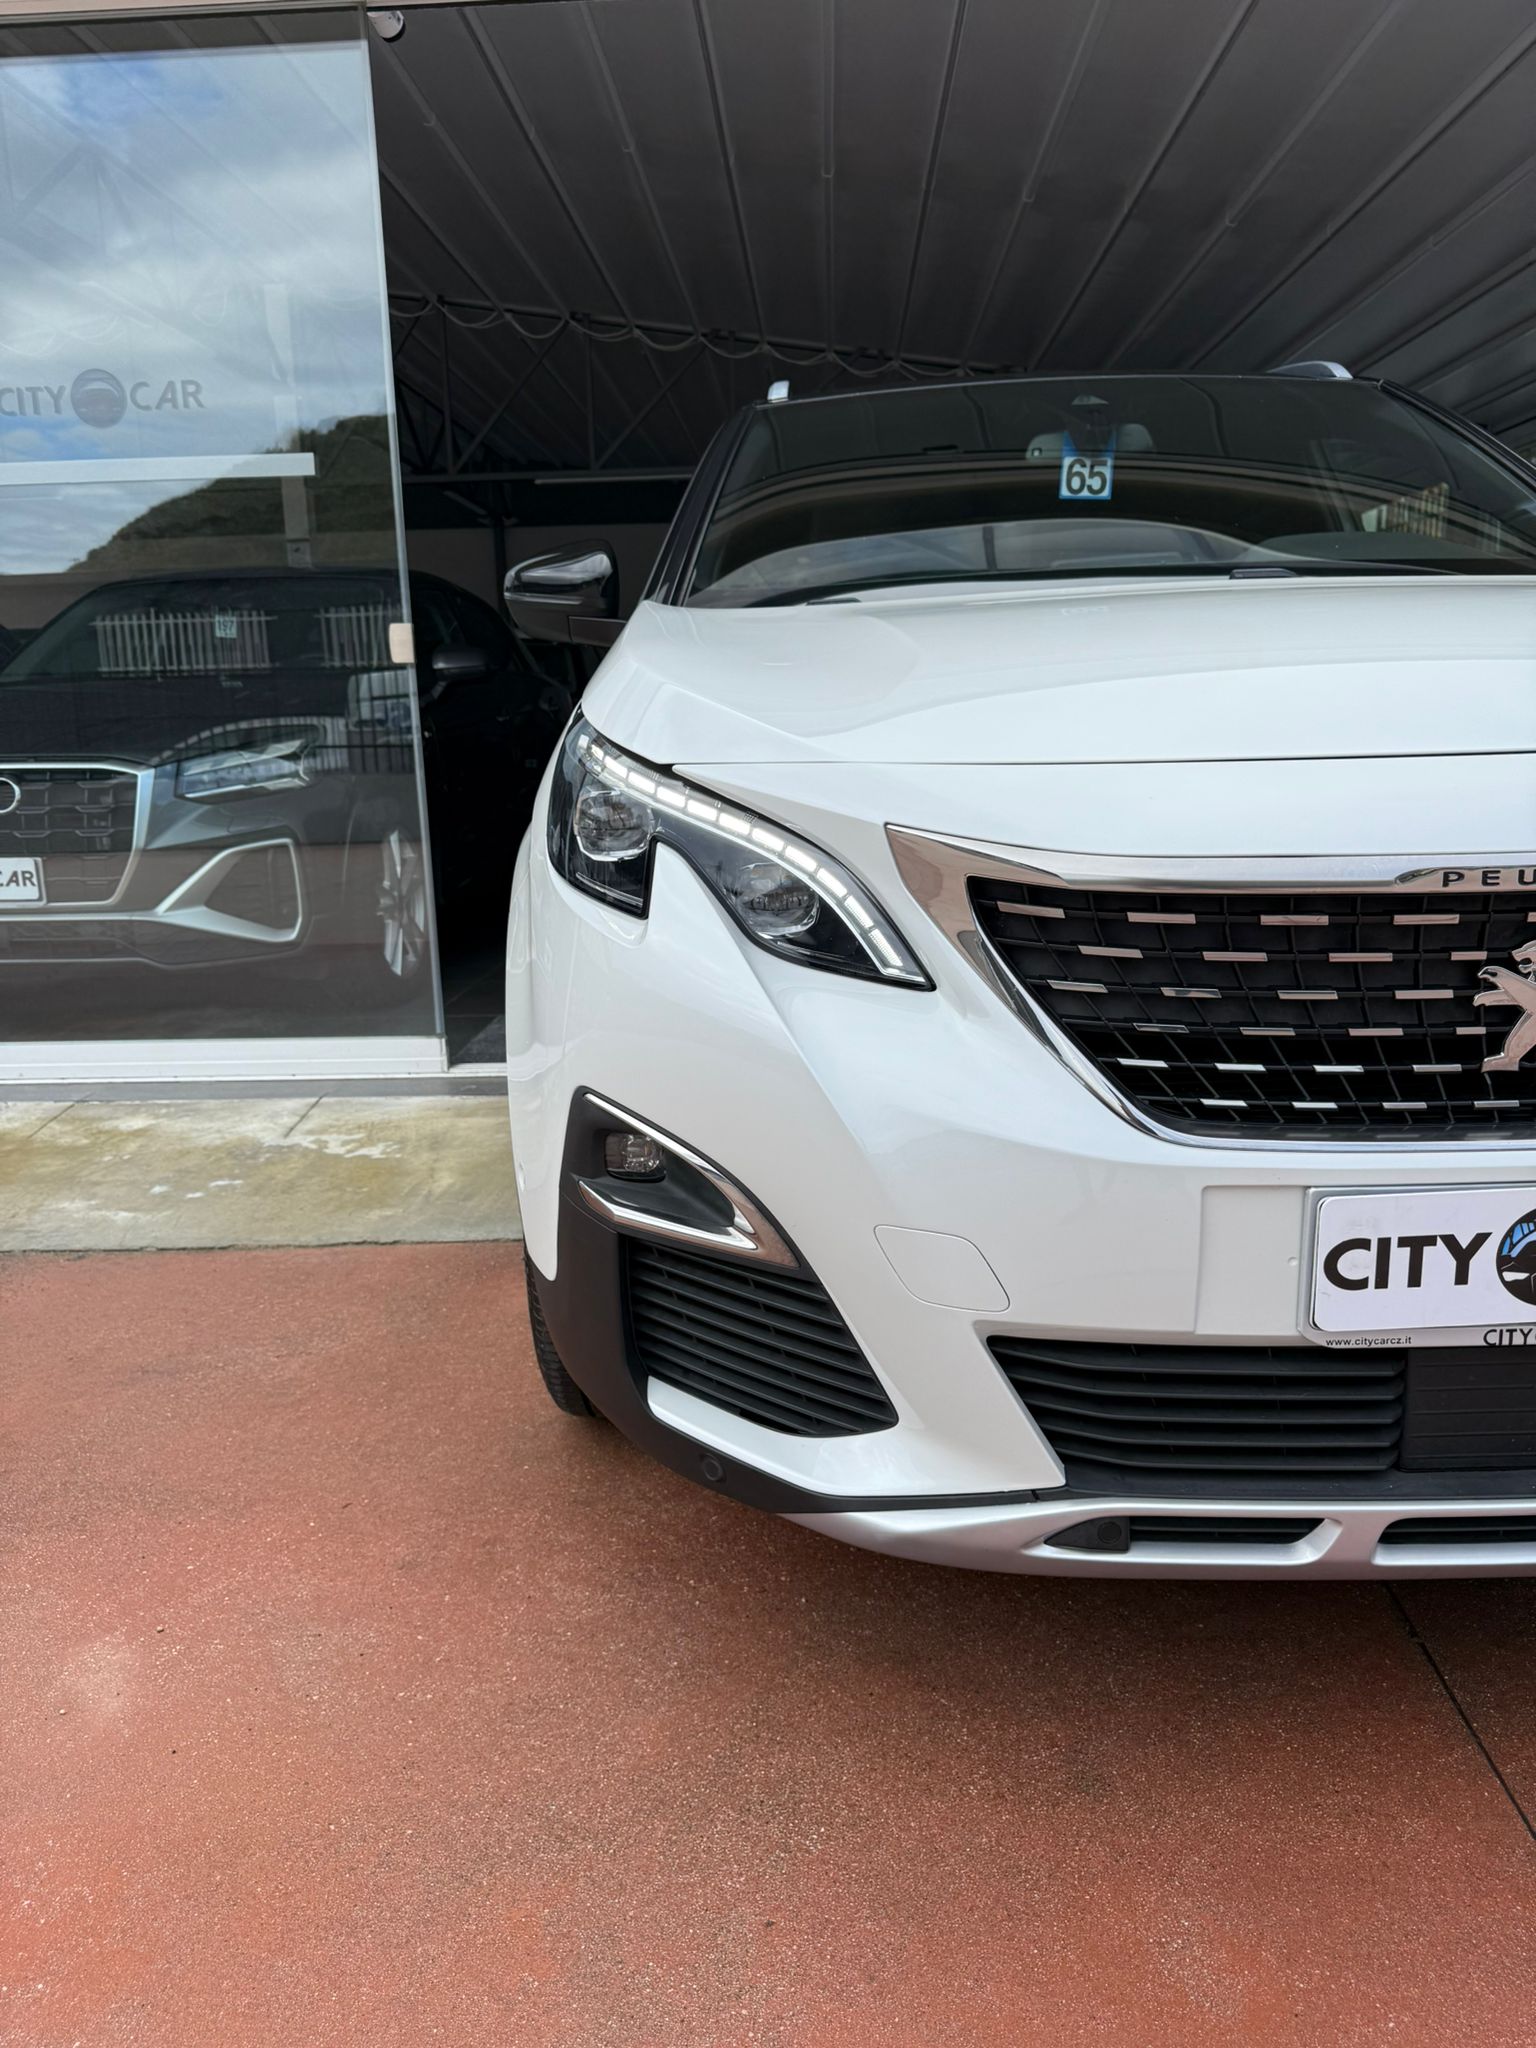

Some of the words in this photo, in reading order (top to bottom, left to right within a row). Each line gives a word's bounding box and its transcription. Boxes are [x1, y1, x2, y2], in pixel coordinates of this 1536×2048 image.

[0, 385, 66, 416] CITY
[130, 379, 206, 411] CAR
[1065, 457, 1108, 496] 65
[0, 871, 36, 888] AR
[1442, 869, 1536, 888] PEU
[1323, 1231, 1493, 1291] CITY
[1325, 1336, 1412, 1348] www.citycarcz.it
[1483, 1328, 1533, 1347] CITY
